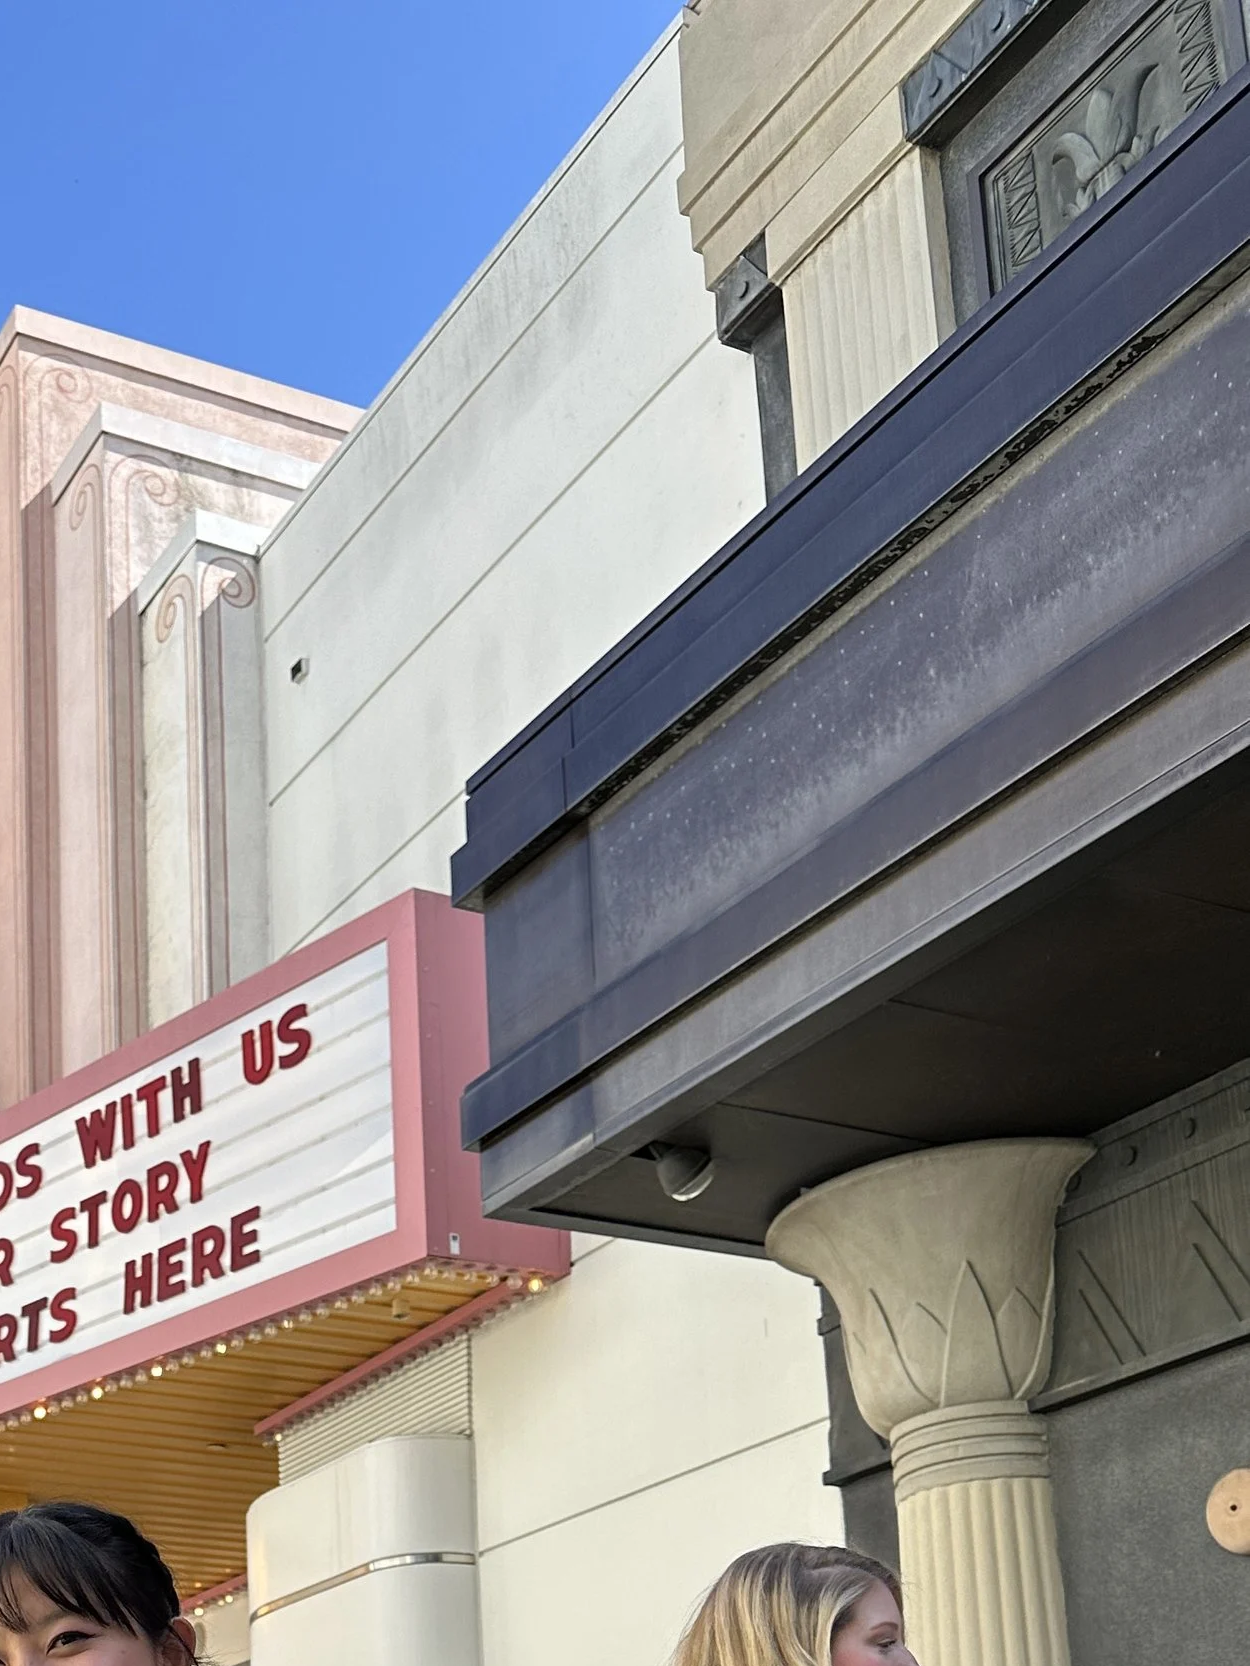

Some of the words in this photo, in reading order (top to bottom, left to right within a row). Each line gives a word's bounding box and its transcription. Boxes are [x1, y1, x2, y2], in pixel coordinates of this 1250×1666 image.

[75, 1057, 204, 1168] WITH
[241, 1003, 313, 1086] US
[49, 1140, 213, 1264] STORY
[122, 1206, 262, 1315] HERE
